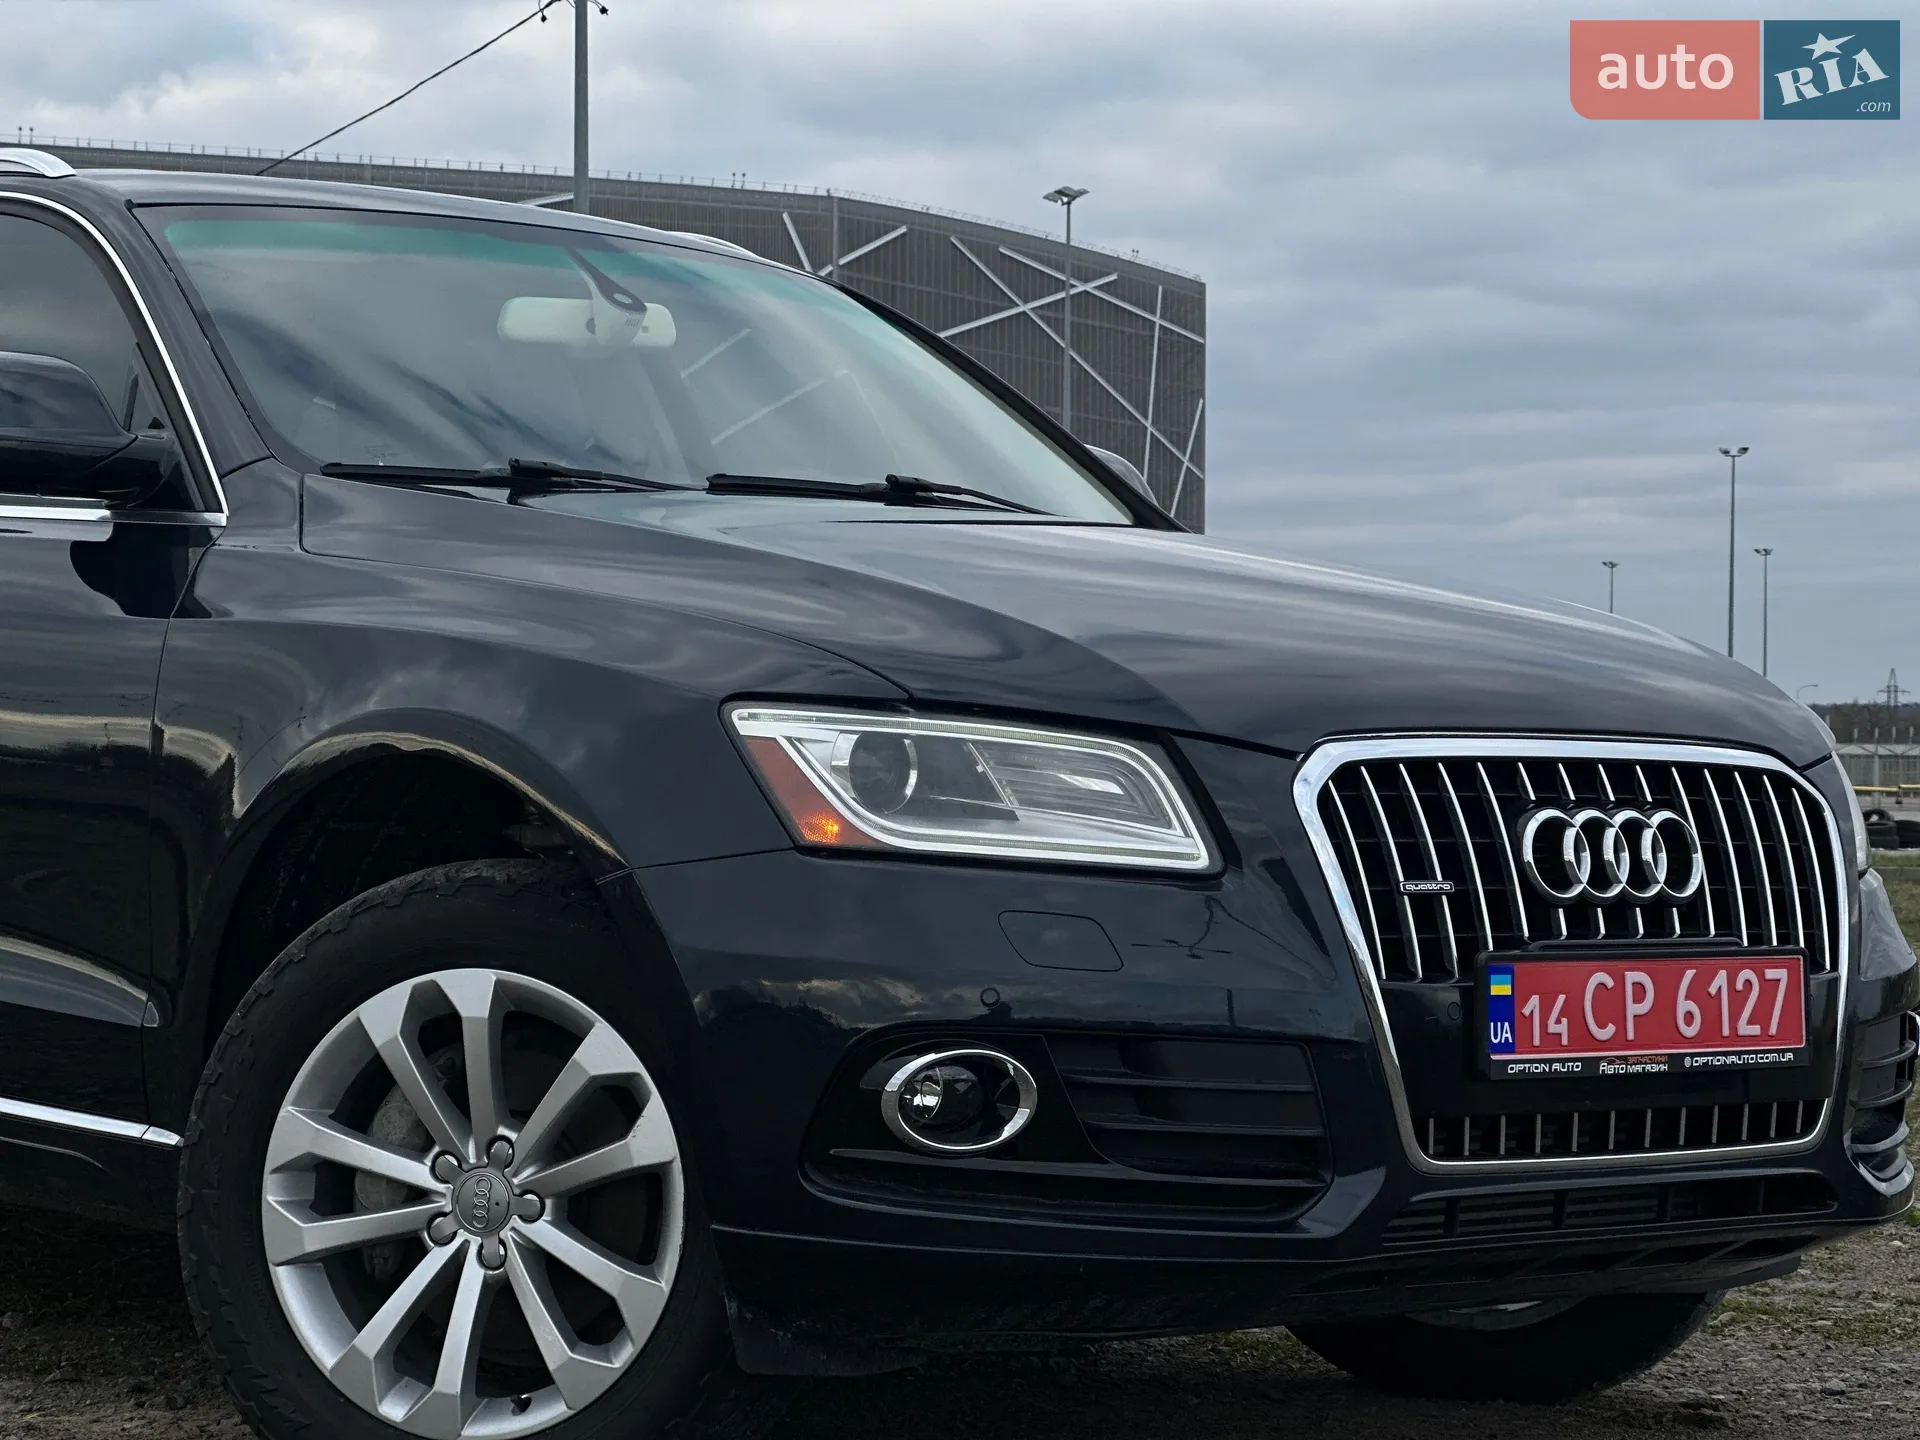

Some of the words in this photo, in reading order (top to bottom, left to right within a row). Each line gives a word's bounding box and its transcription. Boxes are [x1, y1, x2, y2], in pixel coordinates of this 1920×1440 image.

[1405, 883, 1451, 891] quattro
[1521, 994, 1568, 1047] 14
[1583, 971, 1655, 1042] CP
[1676, 968, 1788, 1039] 6127
[1490, 1022, 1513, 1044] UA
[1551, 1062, 1582, 1073] AUTO
